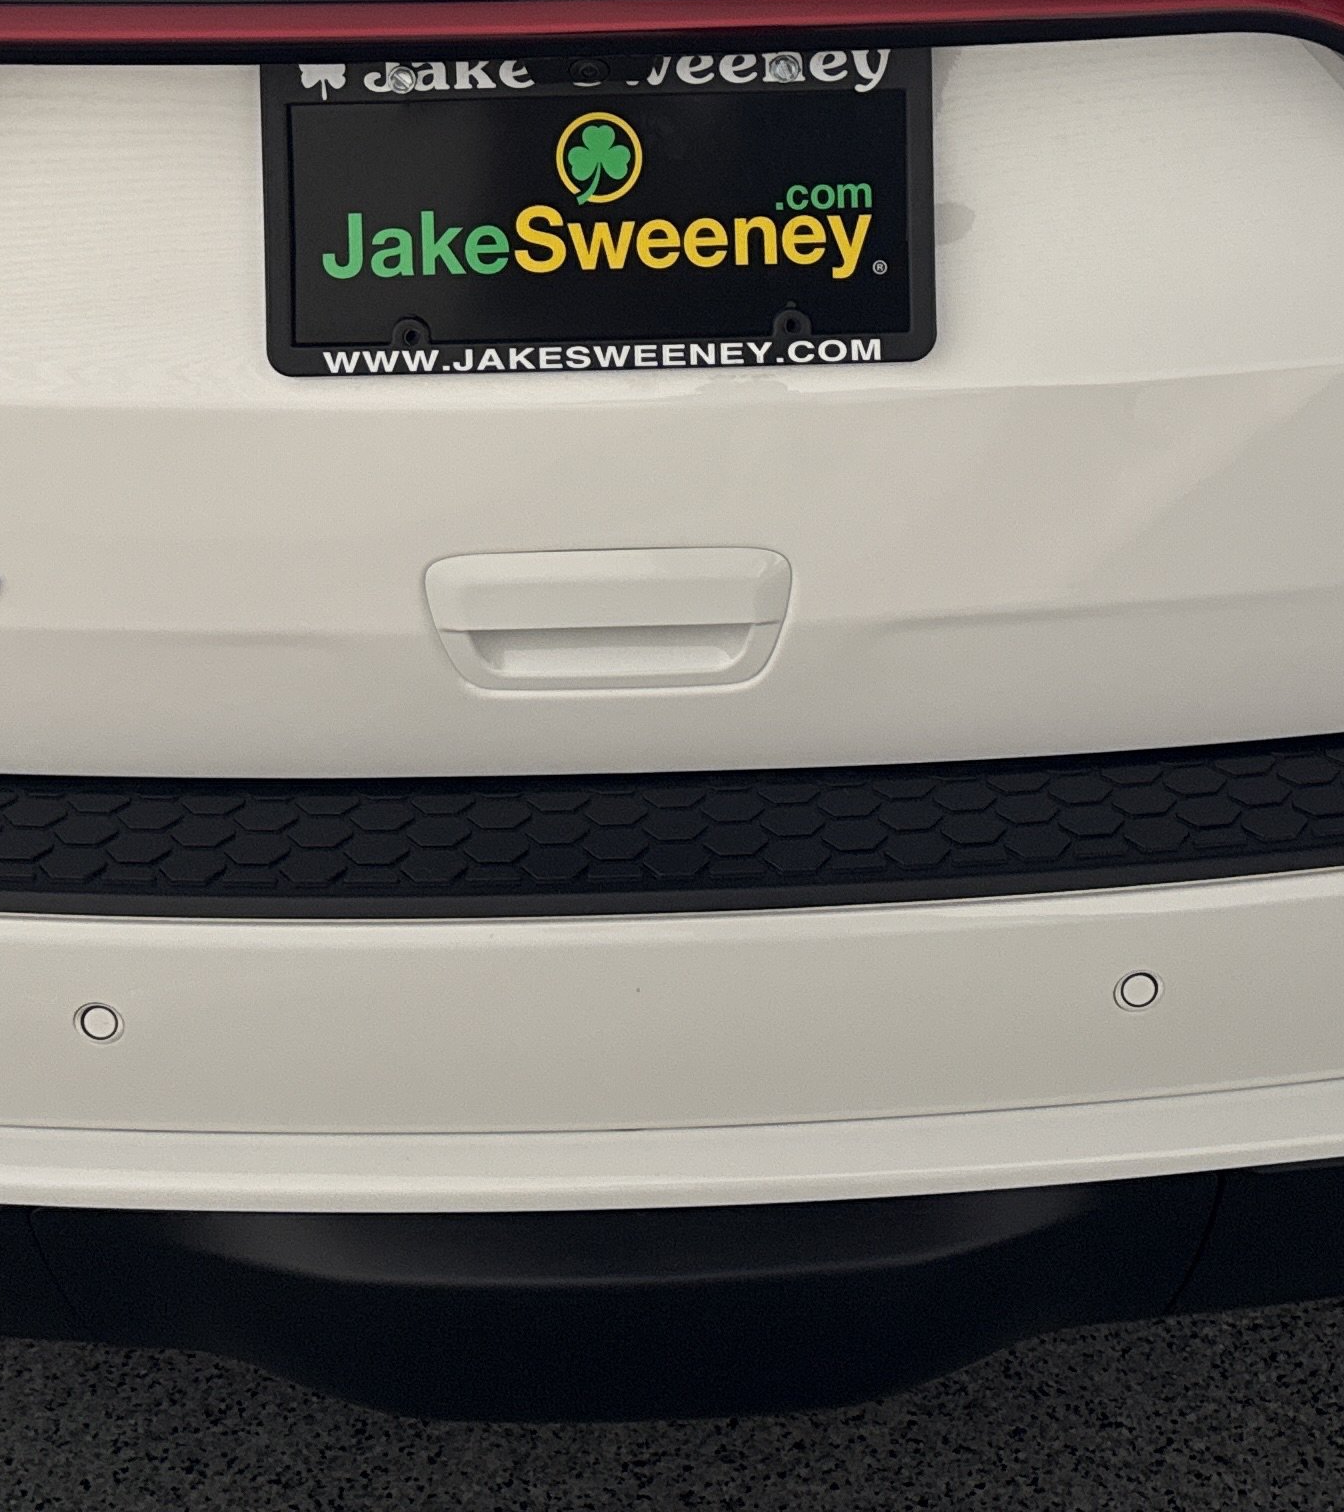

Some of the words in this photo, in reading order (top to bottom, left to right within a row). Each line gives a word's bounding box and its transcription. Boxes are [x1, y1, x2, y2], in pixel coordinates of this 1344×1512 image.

[775, 182, 873, 211] .com
[322, 204, 873, 279] JakeSweeney
[323, 338, 882, 374] WWW.JAKESWEENEY.COM
